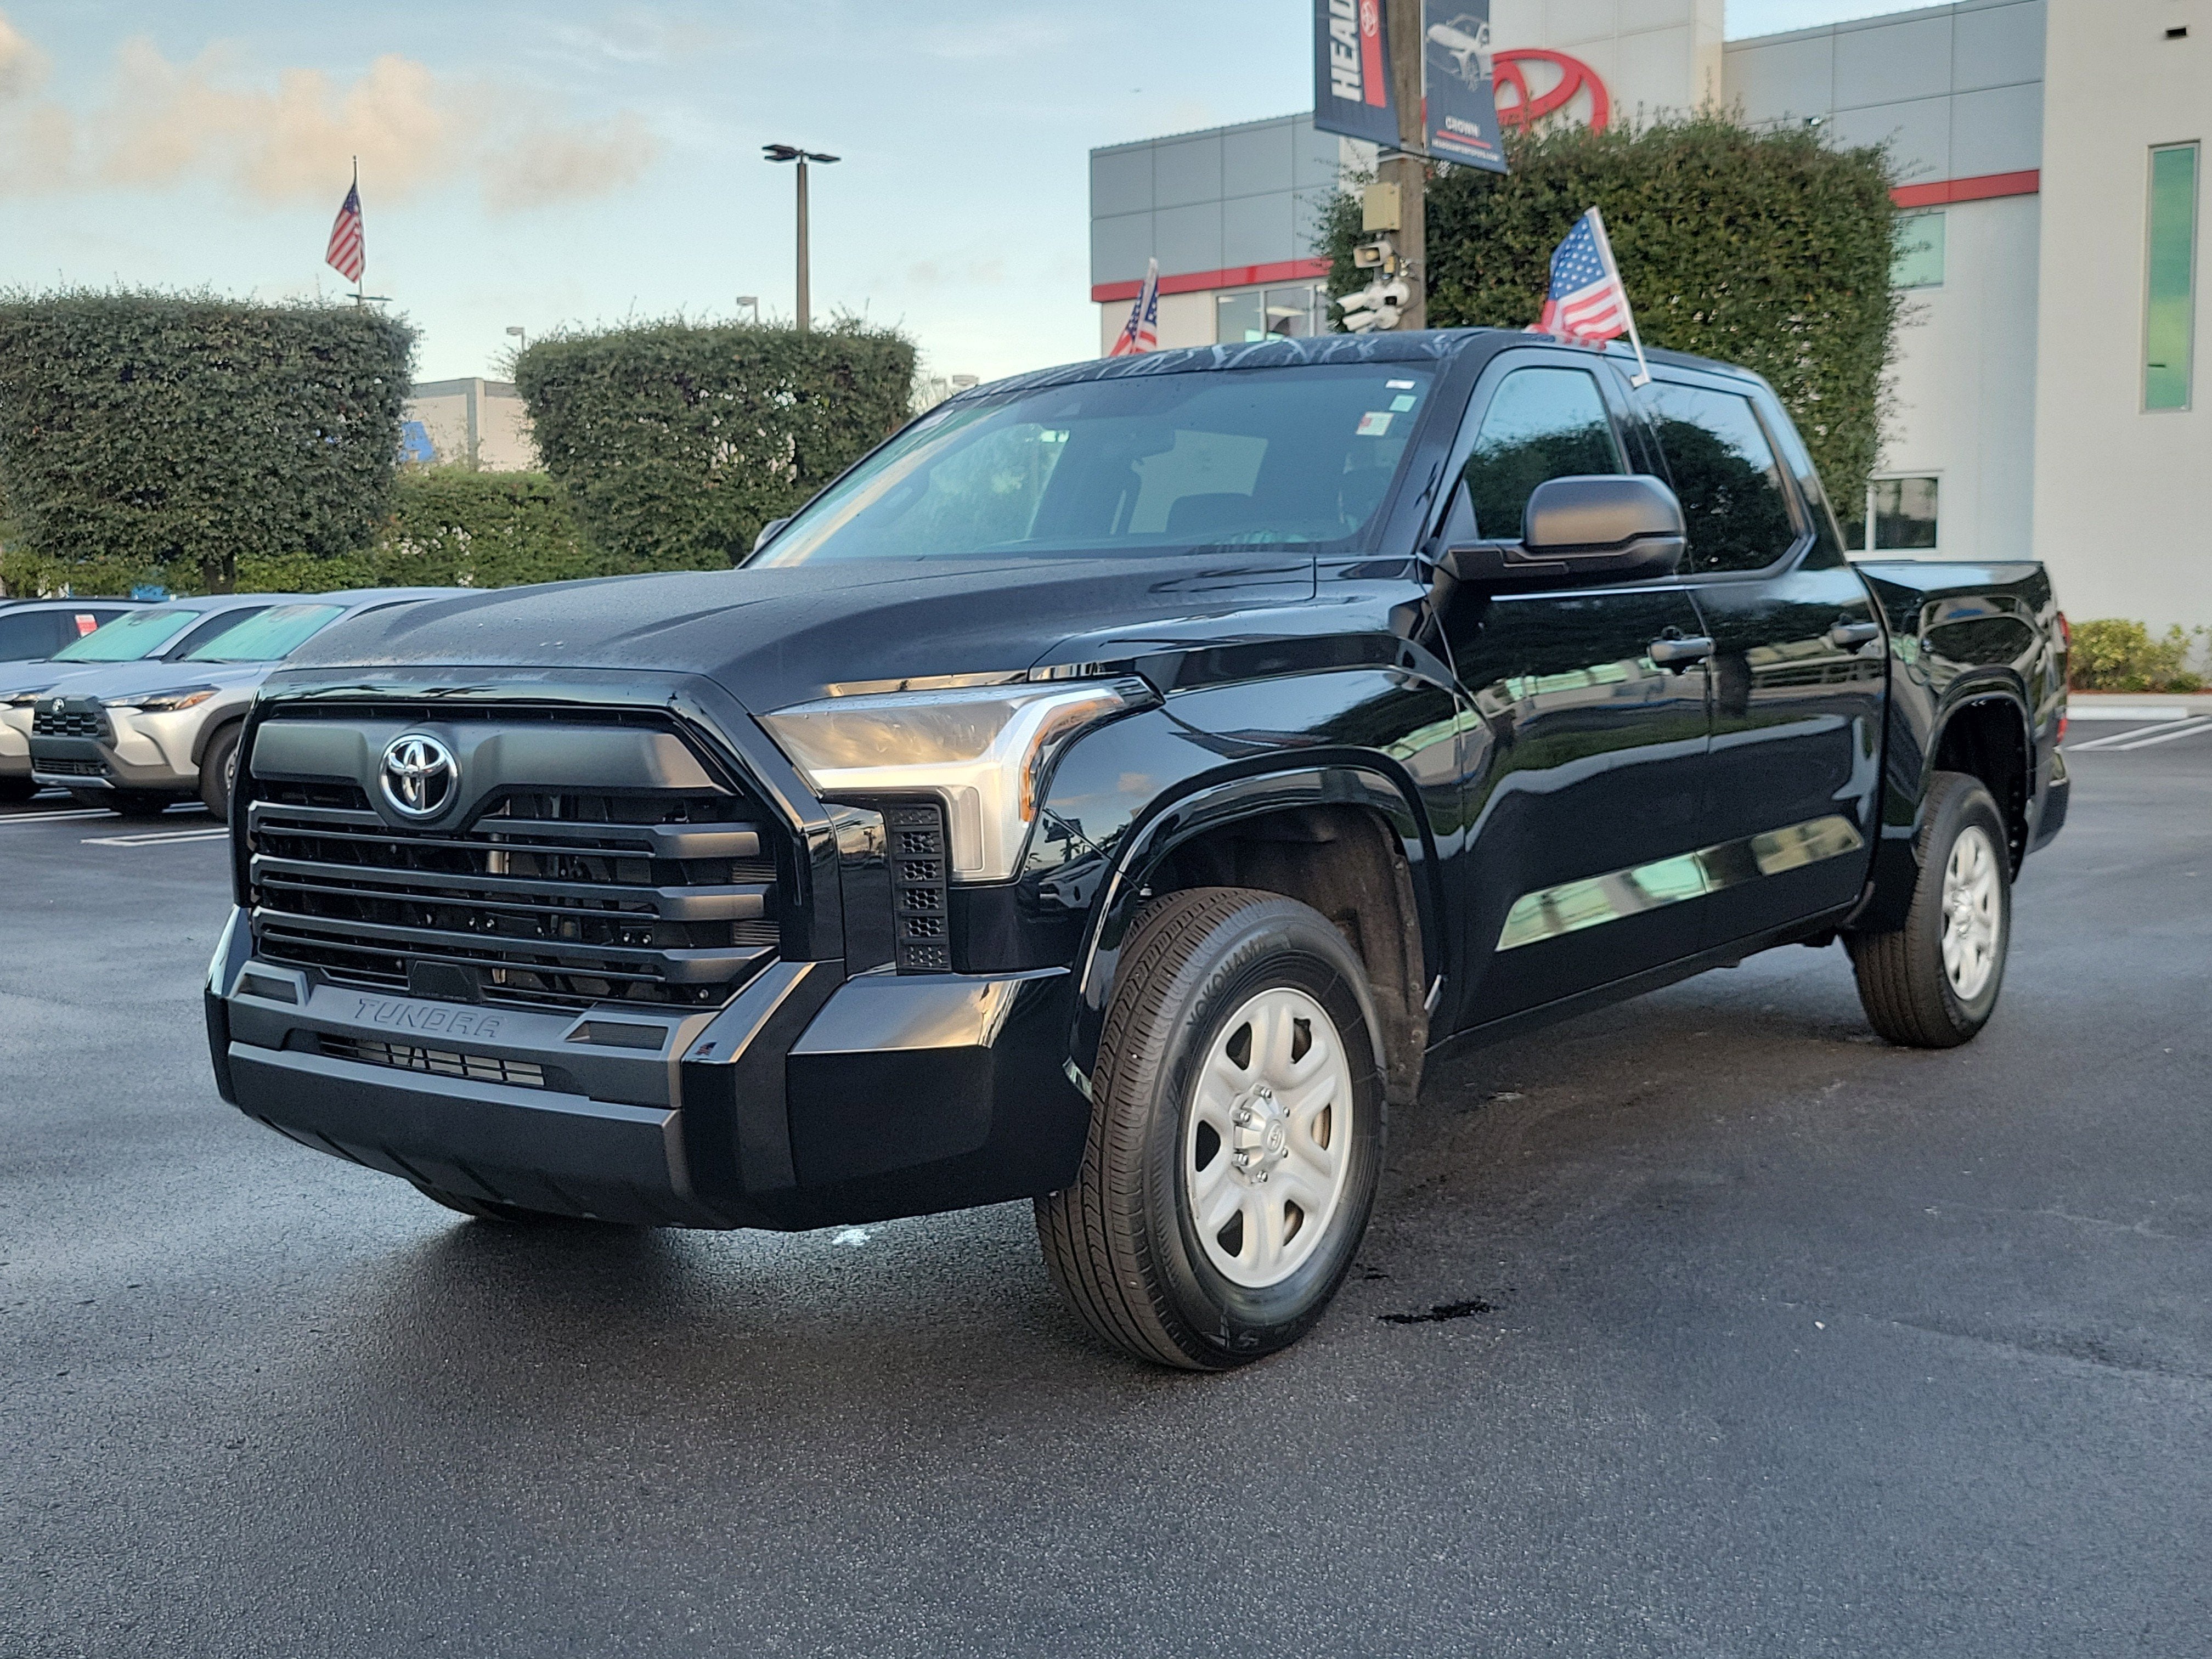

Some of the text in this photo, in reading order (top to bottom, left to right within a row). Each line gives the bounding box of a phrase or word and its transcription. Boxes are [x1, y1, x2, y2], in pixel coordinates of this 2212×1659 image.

[1445, 116, 1480, 137] CROWN
[1186, 935, 1265, 1026] YOKOHAMA
[354, 998, 505, 1037] TUNDRA
